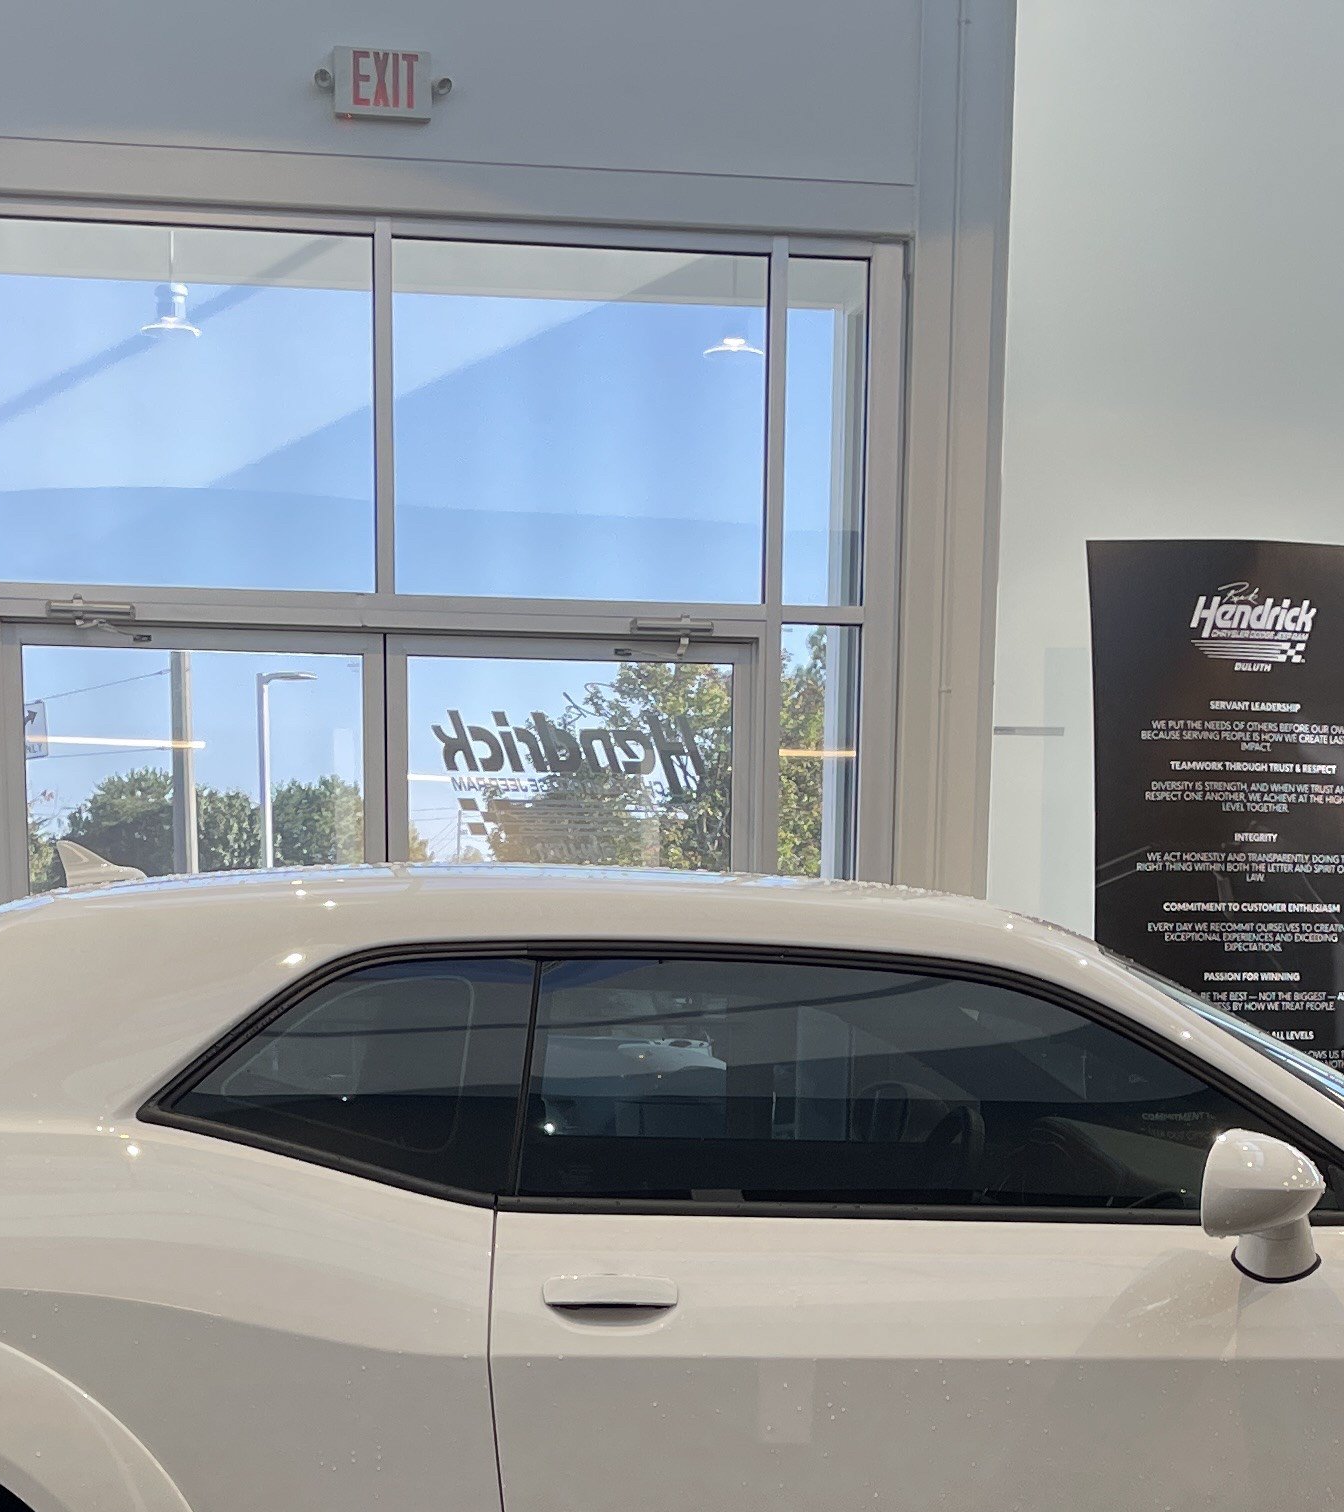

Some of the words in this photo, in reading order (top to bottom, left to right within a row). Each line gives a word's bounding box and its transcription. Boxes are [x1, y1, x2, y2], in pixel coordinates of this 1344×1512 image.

[352, 50, 419, 109] EXIT
[1190, 595, 1317, 638] Hendrick
[1233, 662, 1272, 671] DULUTH
[1208, 700, 1249, 710] SERVANT
[1250, 701, 1301, 712] LEADERSHIP
[1168, 760, 1223, 771] TEAMWORK
[1225, 761, 1267, 771] THROUGH
[1269, 762, 1293, 772] TRUST
[1294, 763, 1301, 772] &
[1301, 764, 1337, 774] RESPECT
[1233, 832, 1278, 842] INTEGRITY
[1161, 901, 1225, 912] COMMITMENT
[1228, 902, 1239, 911] TO
[1240, 902, 1286, 912] CUSTOMER
[1287, 902, 1341, 913] ENTHUSIASM
[1202, 971, 1241, 981] PASSION
[1241, 971, 1259, 981] FOR
[1259, 971, 1301, 981] WINNING
